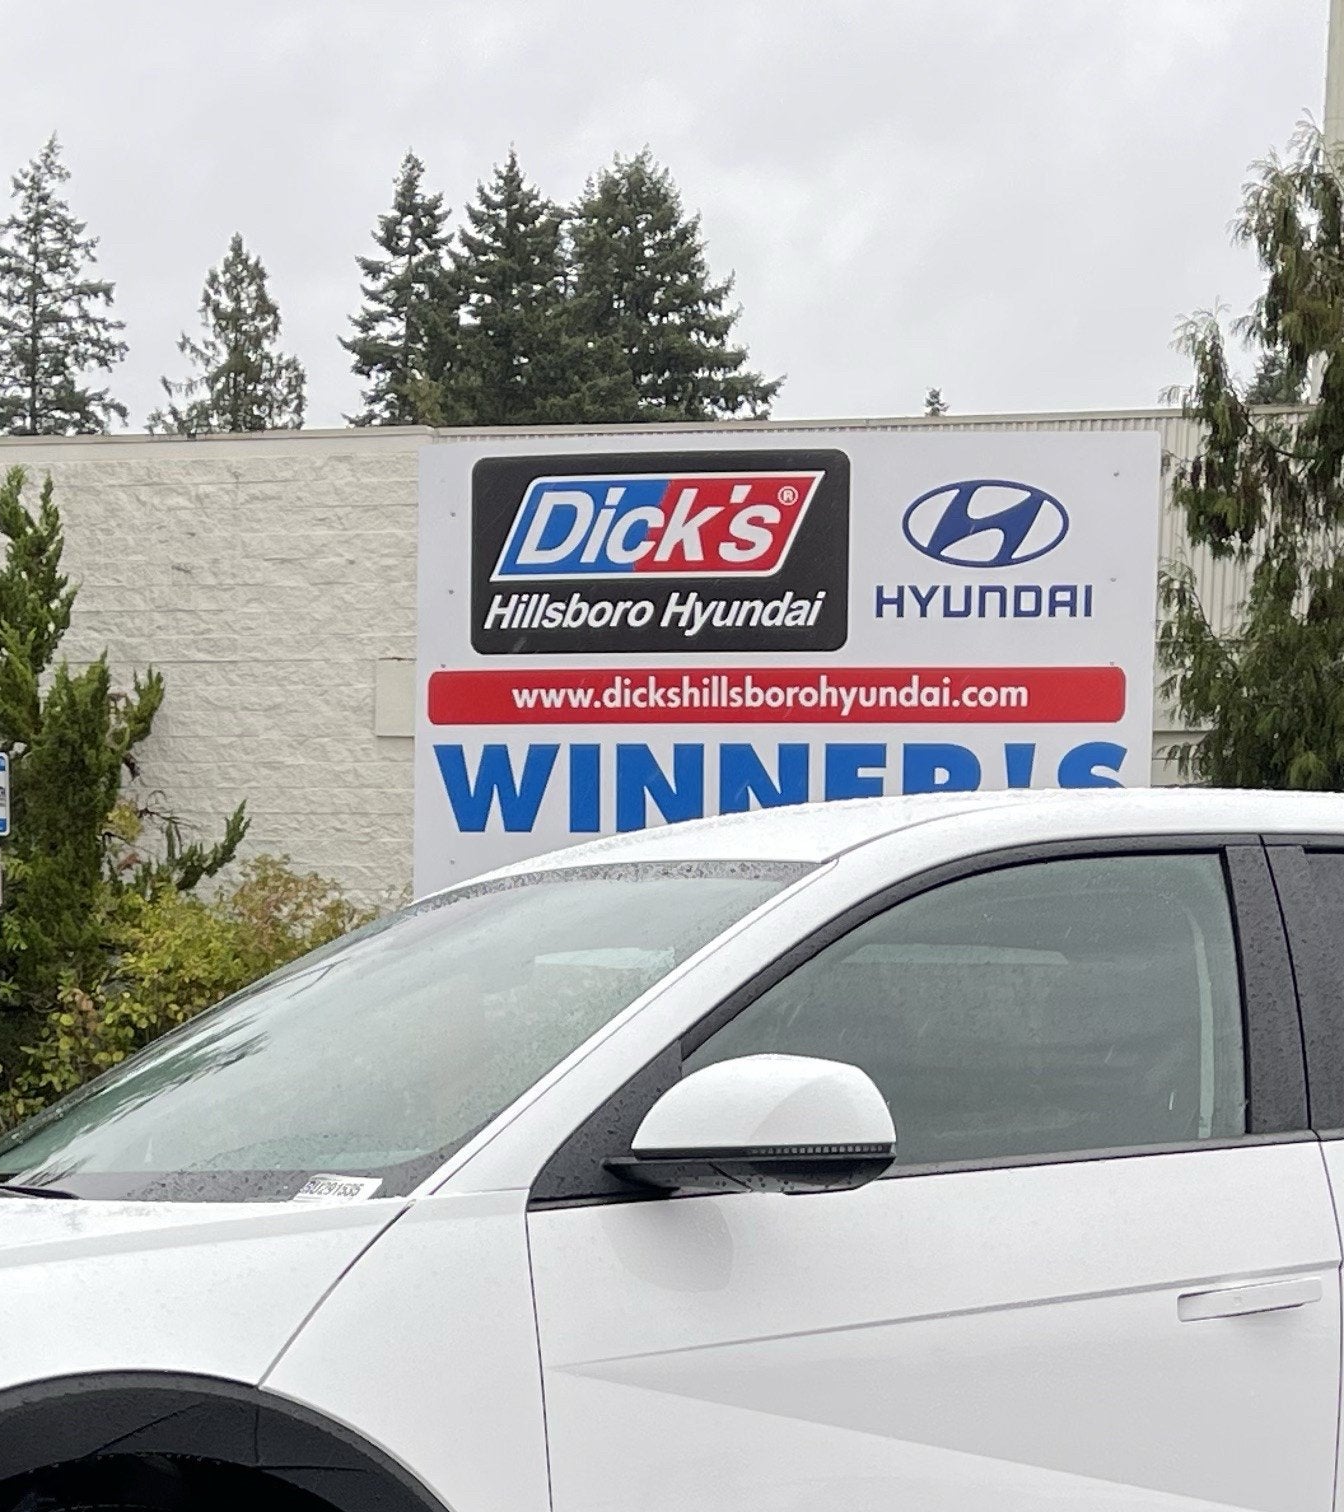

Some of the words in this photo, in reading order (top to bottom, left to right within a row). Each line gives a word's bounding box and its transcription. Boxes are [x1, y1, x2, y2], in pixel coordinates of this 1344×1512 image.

[515, 485, 782, 566] Dick's
[484, 592, 654, 631] Hillsboro
[659, 590, 827, 637] Hyundai
[875, 584, 1093, 619] HYUNDAI
[512, 675, 1028, 715] www.dickshillsborohyundai.com
